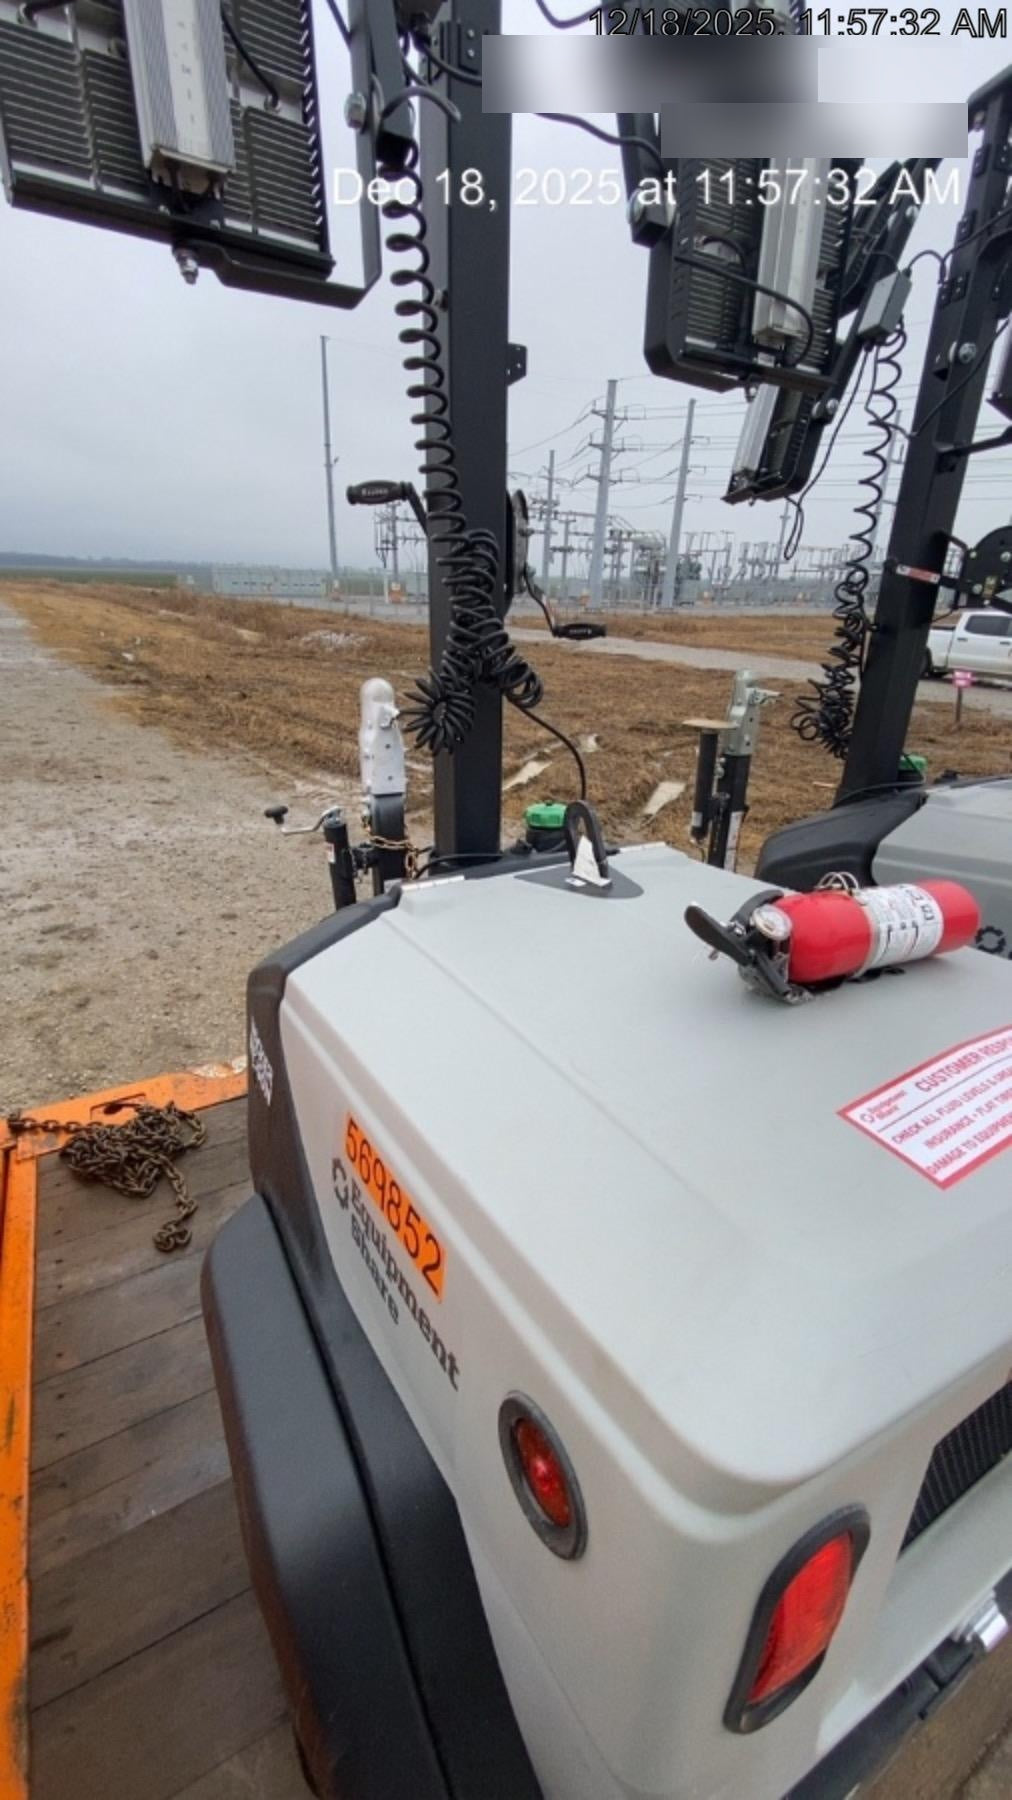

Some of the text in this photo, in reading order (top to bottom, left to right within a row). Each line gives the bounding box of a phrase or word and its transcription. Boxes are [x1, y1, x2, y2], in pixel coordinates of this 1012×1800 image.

[915, 1051, 980, 1092] CUSTOMER
[346, 1116, 442, 1297] 569852
[350, 1213, 400, 1326] Share
[351, 1180, 460, 1392] Equipment
